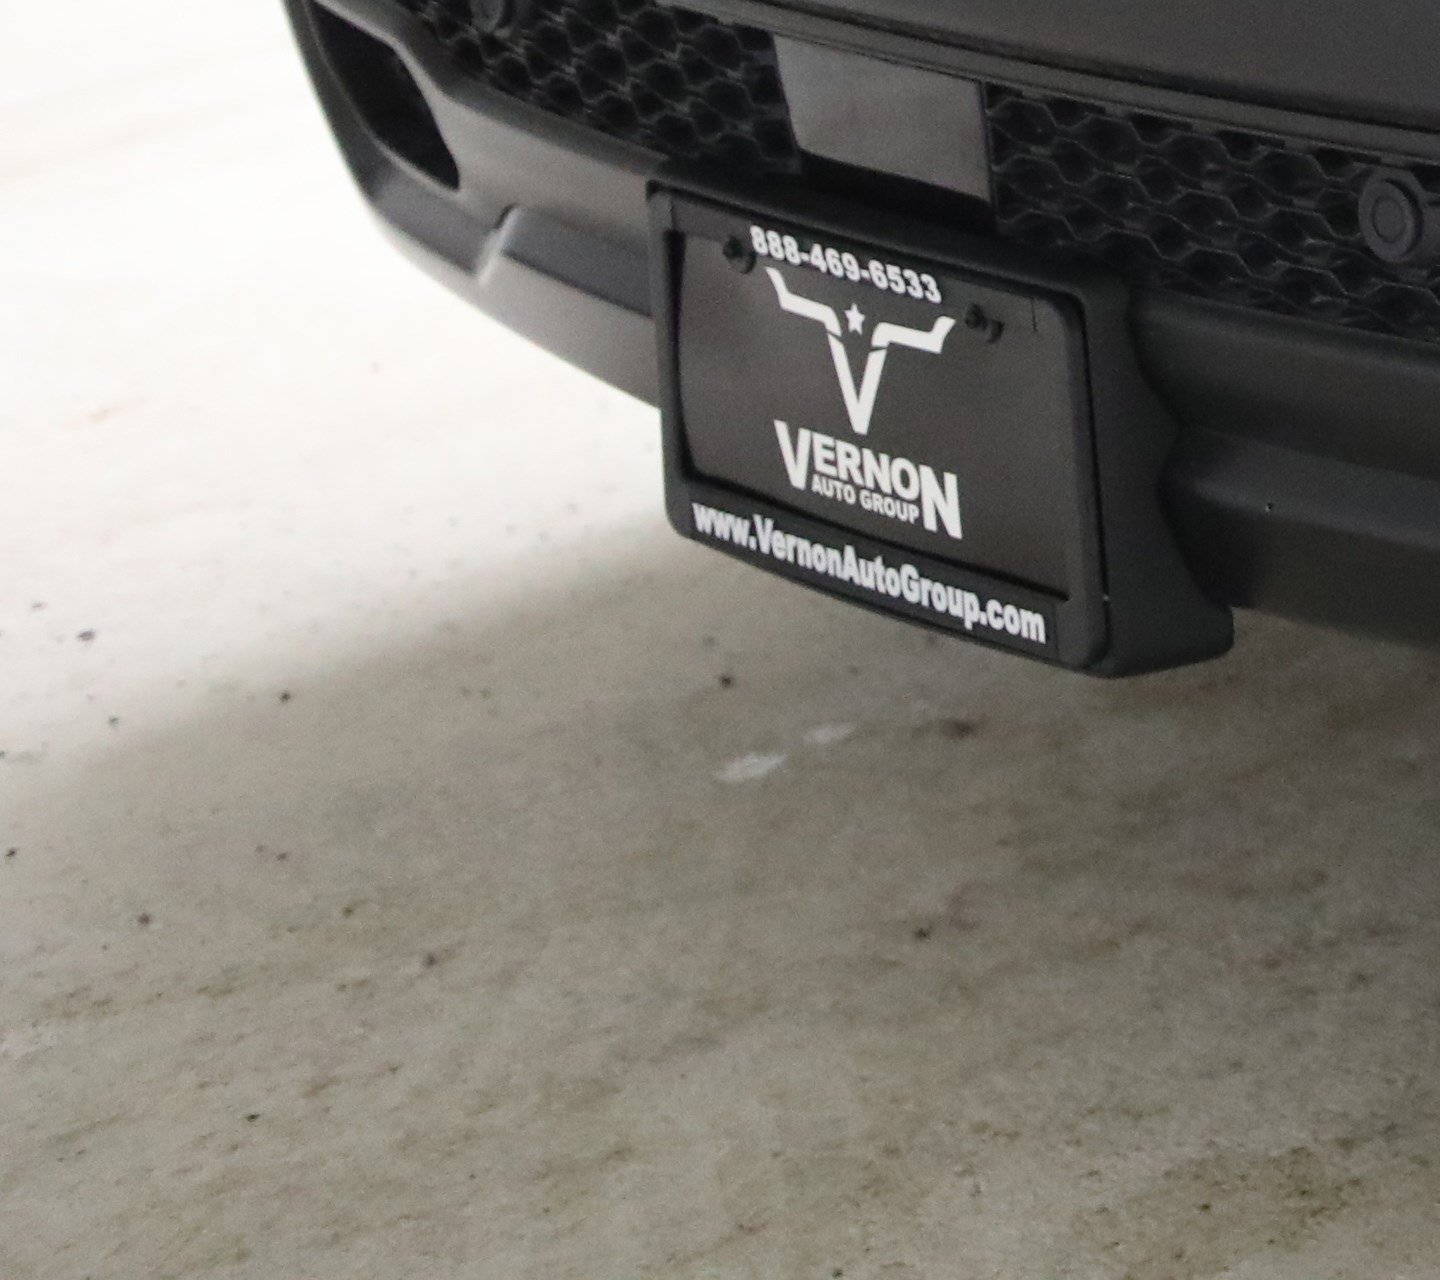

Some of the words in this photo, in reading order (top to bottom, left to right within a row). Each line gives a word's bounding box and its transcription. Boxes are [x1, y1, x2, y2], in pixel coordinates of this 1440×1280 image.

[750, 225, 942, 304] 888-469-6533
[774, 420, 962, 539] VERNON
[811, 475, 857, 506] AUTO
[860, 489, 919, 524] GROUP
[693, 502, 1046, 644] www.VernonAutoGroup.com
